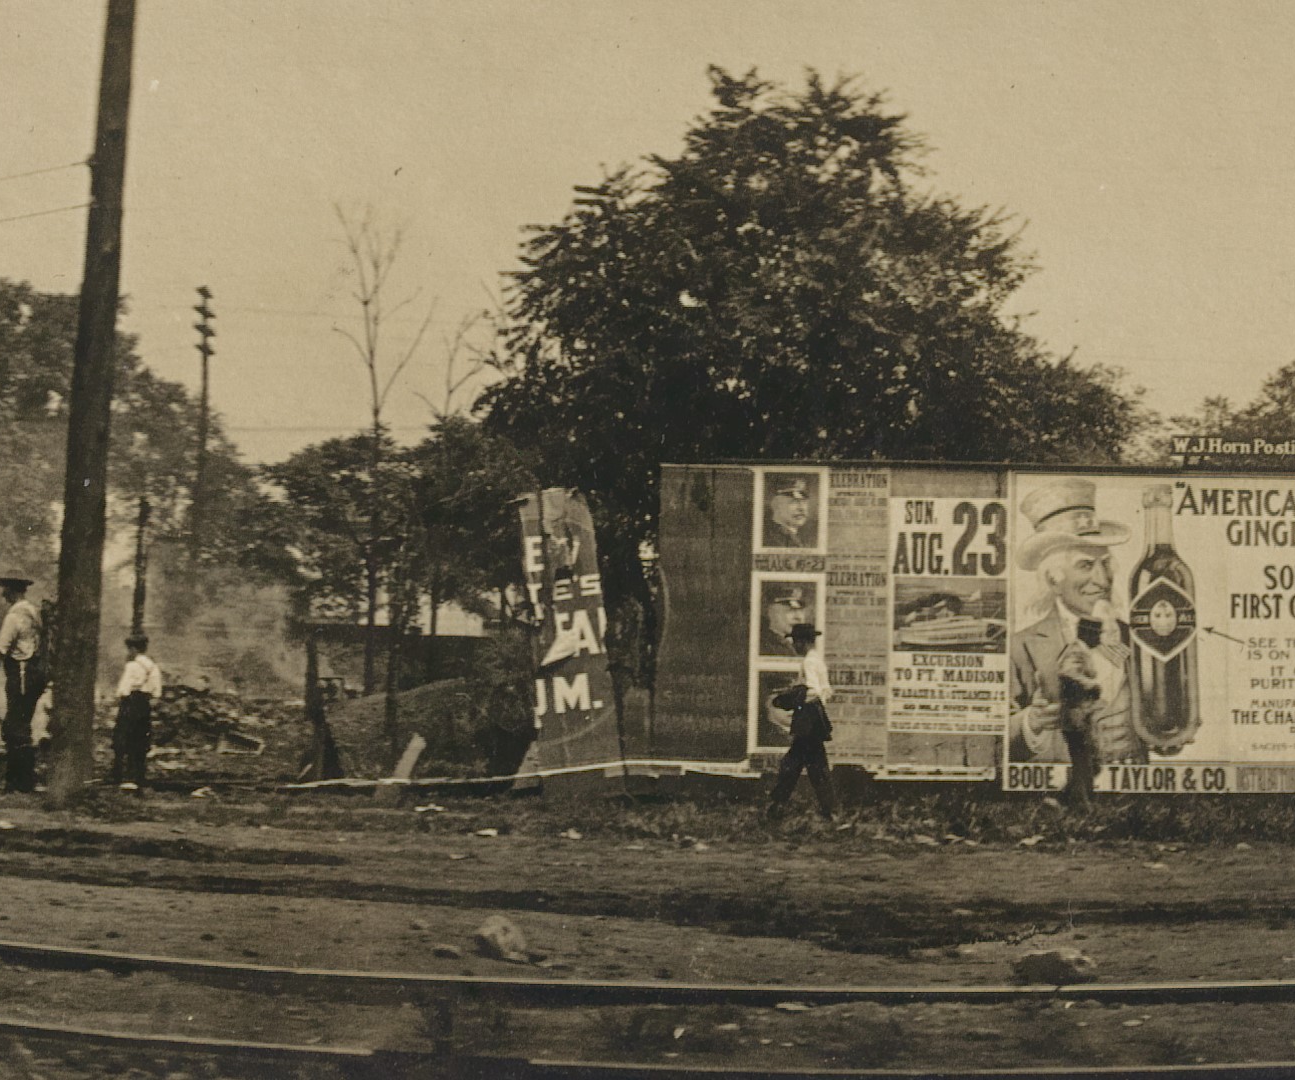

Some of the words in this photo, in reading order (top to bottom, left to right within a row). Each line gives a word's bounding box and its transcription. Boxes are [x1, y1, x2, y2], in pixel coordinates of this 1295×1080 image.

[904, 500, 937, 525] SUN.
[951, 501, 1008, 576] 23
[892, 531, 950, 575] AUG.
[1230, 593, 1283, 620] FIRST
[1247, 637, 1278, 649] SEE
[911, 653, 985, 668] EXCURSION
[1247, 649, 1263, 660] IS
[1268, 649, 1289, 660] ON
[893, 667, 913, 681] TO
[916, 668, 938, 682] FT.
[941, 669, 1006, 684] MADISON
[1270, 665, 1285, 677] IT
[1231, 709, 1260, 725] THE
[1108, 767, 1177, 791] TAYLOR
[1182, 767, 1197, 790] &
[1202, 767, 1231, 792] CO.
